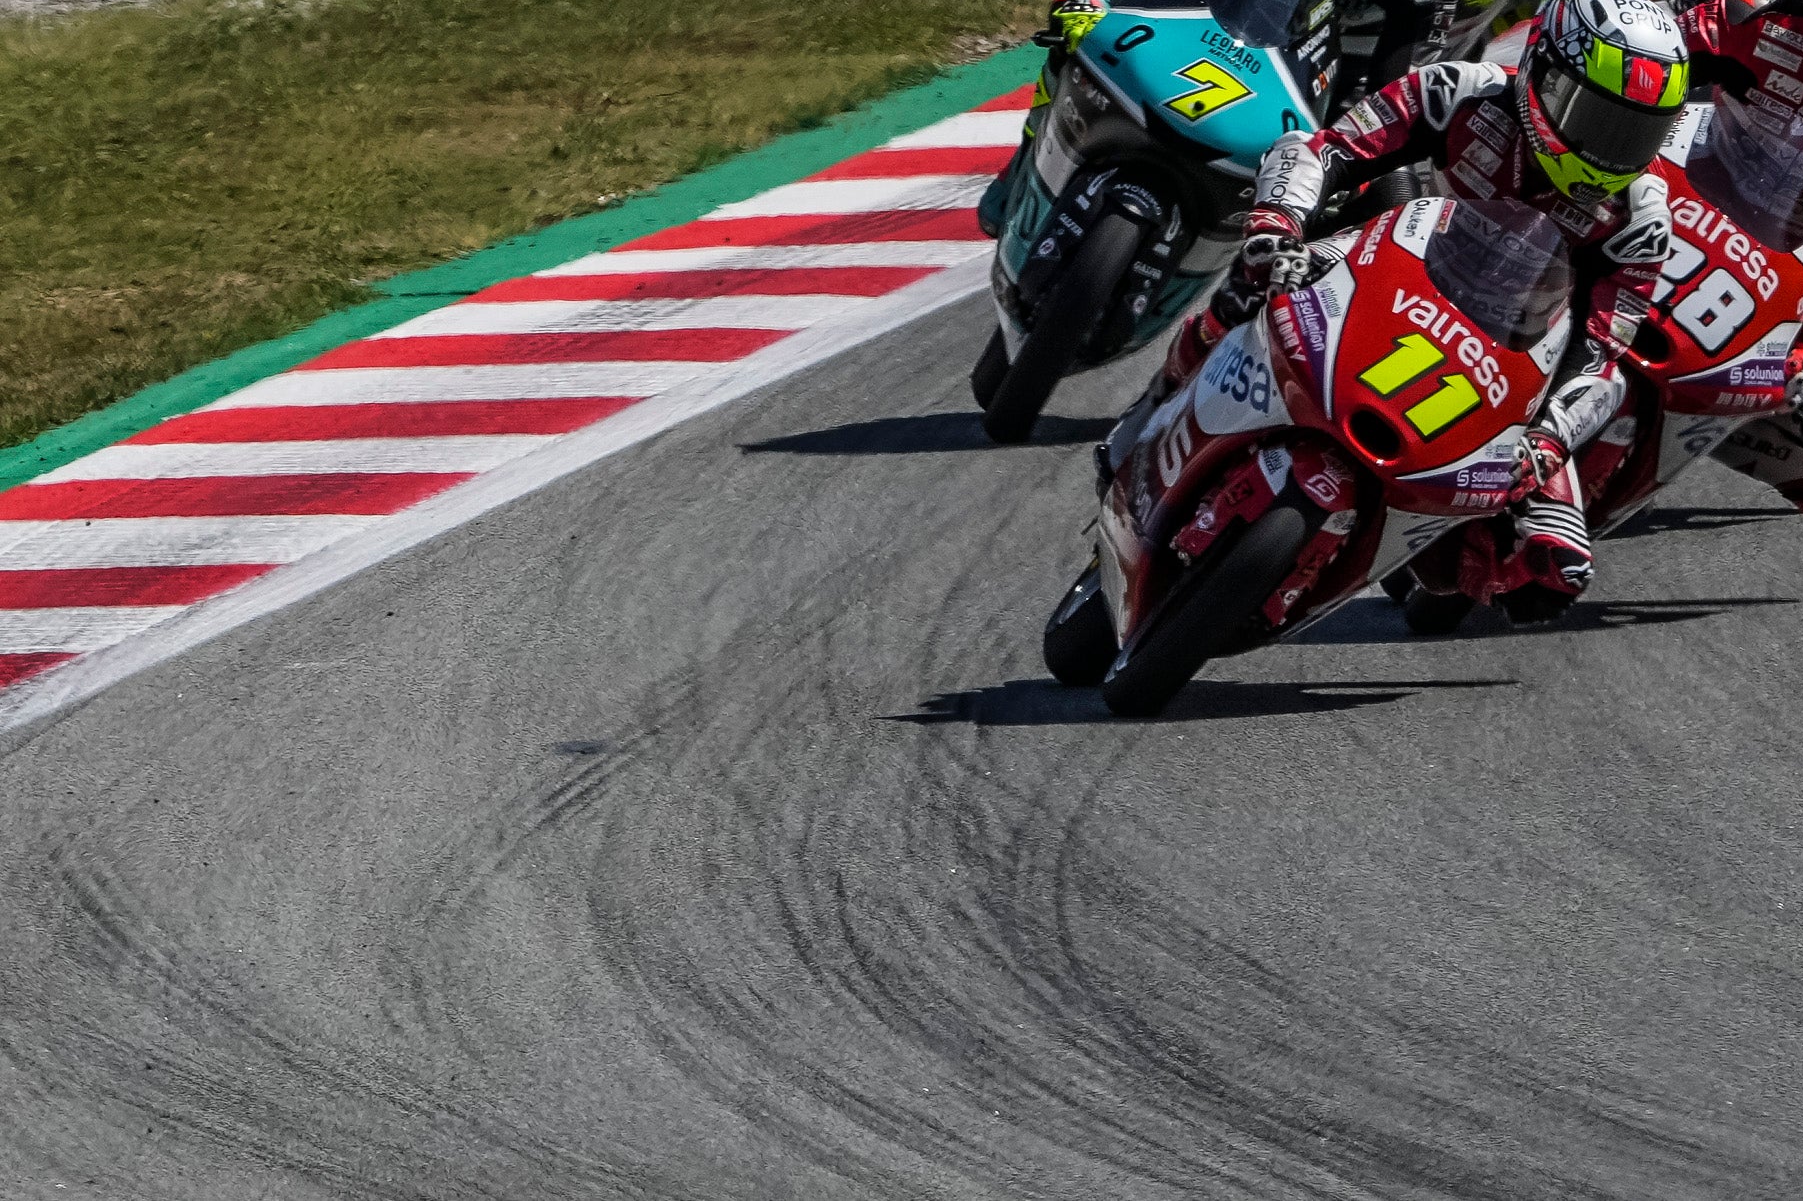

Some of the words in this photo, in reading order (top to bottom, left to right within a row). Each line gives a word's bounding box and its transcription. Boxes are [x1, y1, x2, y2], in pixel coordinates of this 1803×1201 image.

[1163, 58, 1258, 123] 7
[1200, 29, 1262, 76] LEOPARD
[1358, 332, 1482, 439] 11
[1391, 287, 1510, 410] valresa
